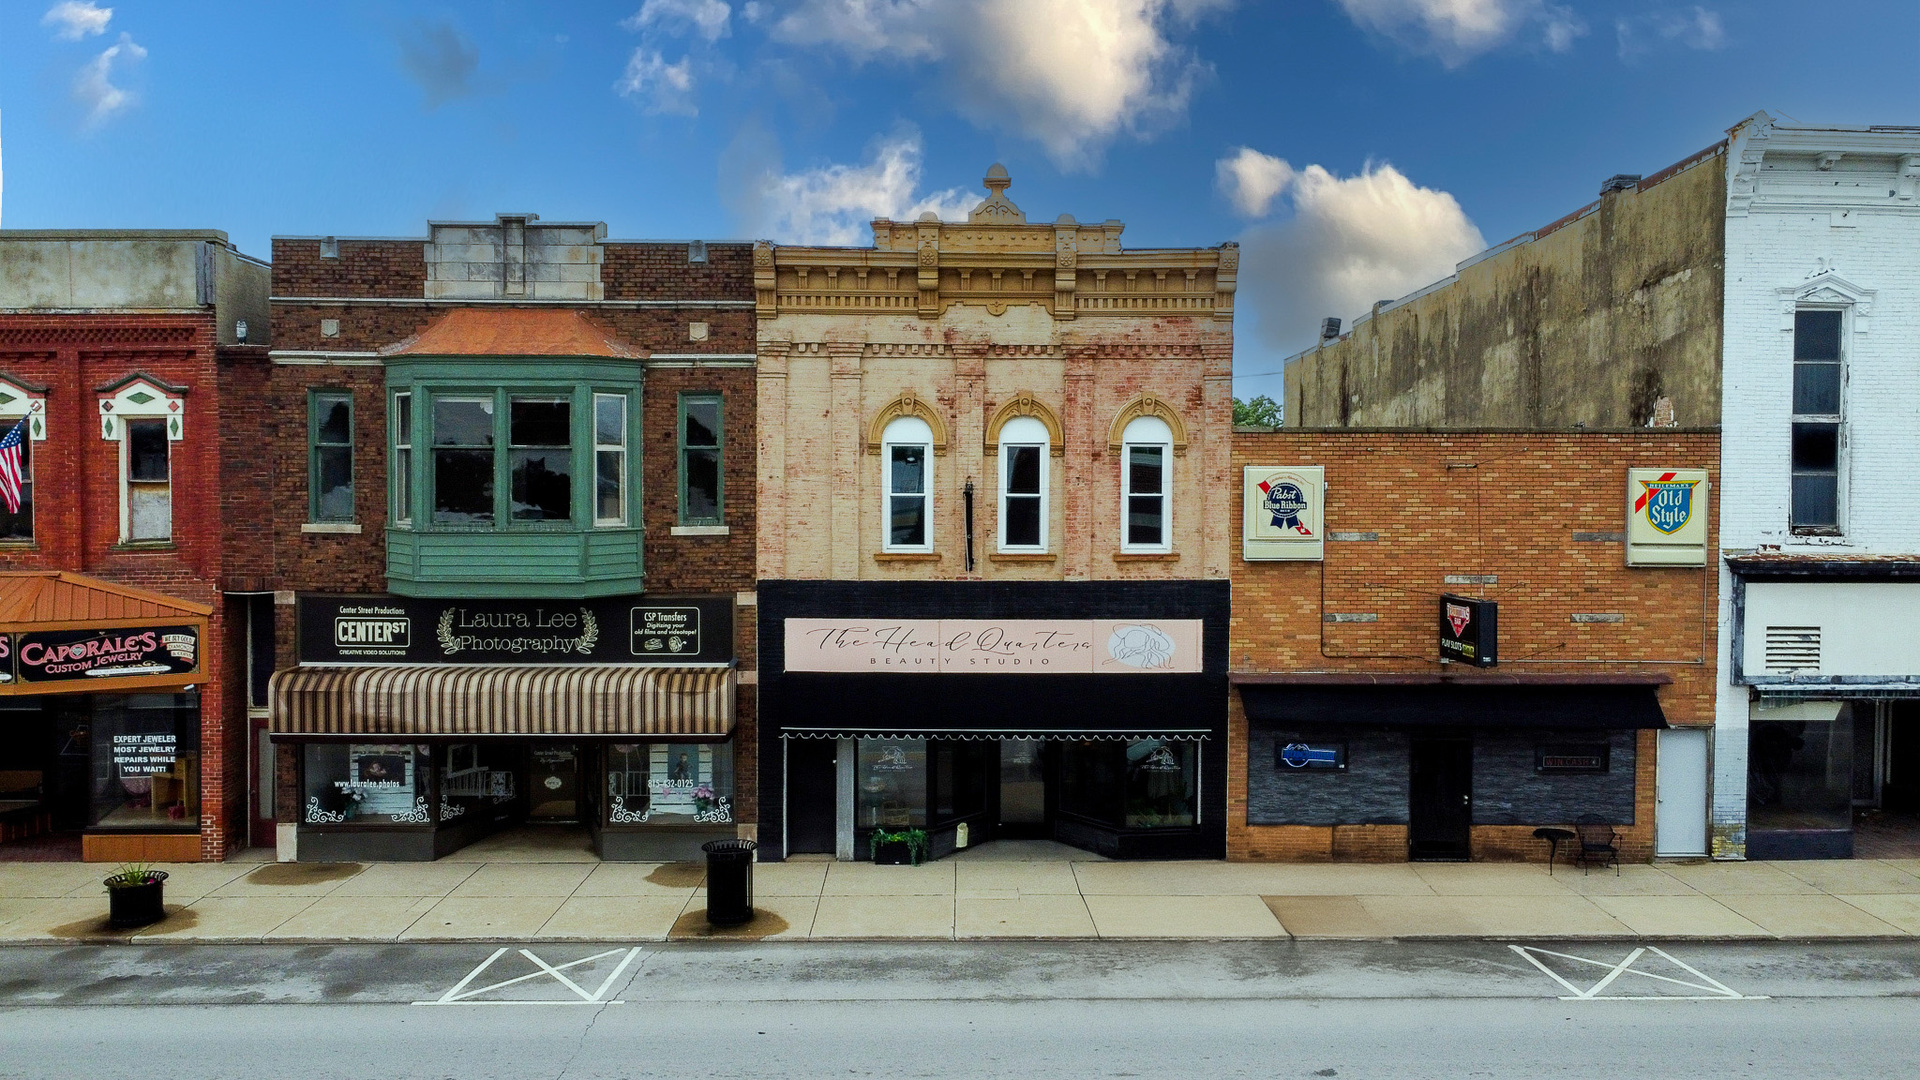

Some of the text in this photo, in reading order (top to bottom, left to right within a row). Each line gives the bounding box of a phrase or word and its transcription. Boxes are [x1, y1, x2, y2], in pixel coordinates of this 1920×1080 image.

[1272, 488, 1296, 499] Pabst
[1658, 490, 1682, 506] Old
[1264, 501, 1306, 509] Blue Ribbon
[1652, 505, 1686, 529] Style
[340, 605, 405, 615] Center Street Productions
[644, 612, 686, 621] CSP Transfers
[459, 608, 577, 628] Laura Lee
[459, 635, 576, 654] Photography
[806, 626, 1094, 655] The Head Quarters
[20, 632, 156, 666] CAPORALE'S
[45, 662, 92, 674] CUSTOM
[94, 652, 143, 667] JEWELRY
[869, 657, 1050, 665] BEAUTY STUDIO
[113, 735, 176, 743] EXPERT JEWELER
[334, 779, 400, 789] www.lauralee.photos
